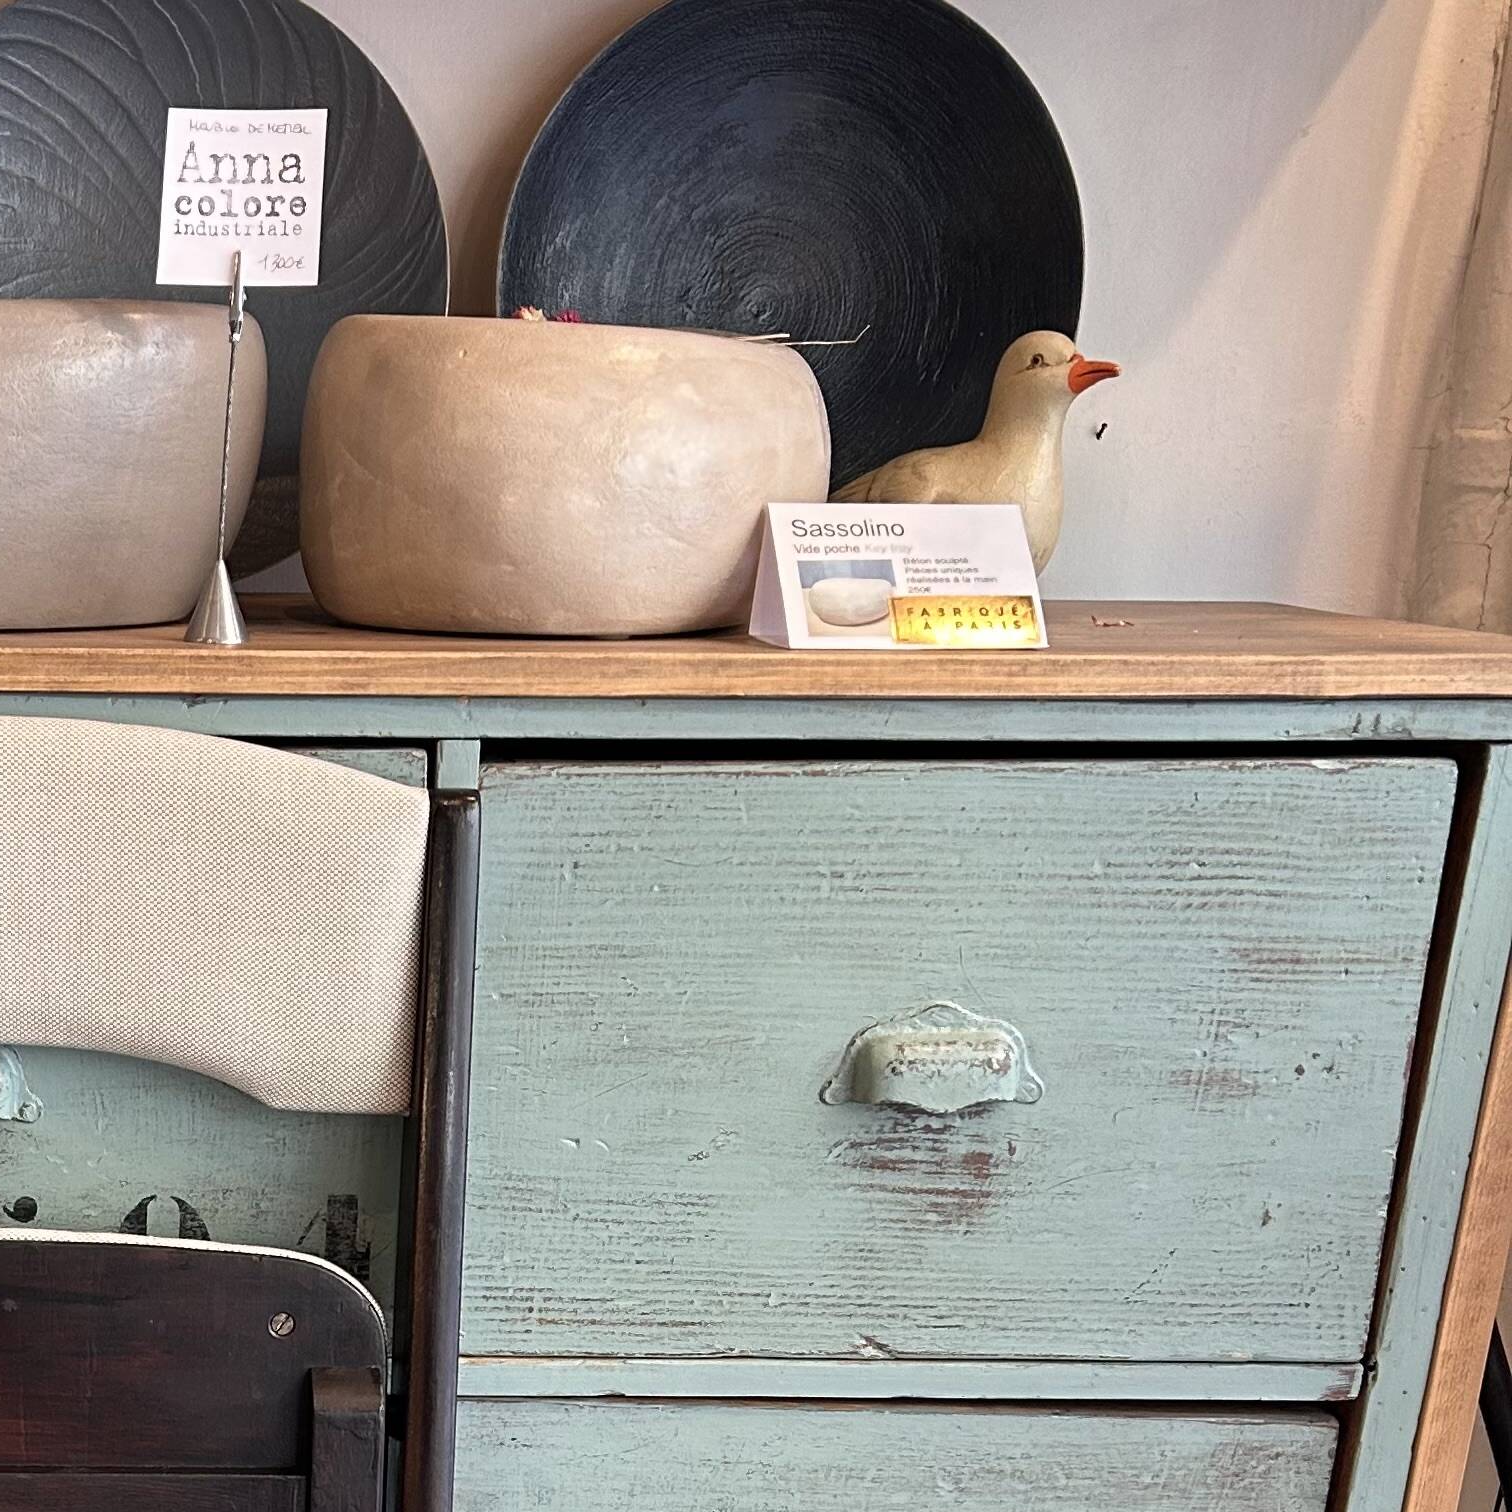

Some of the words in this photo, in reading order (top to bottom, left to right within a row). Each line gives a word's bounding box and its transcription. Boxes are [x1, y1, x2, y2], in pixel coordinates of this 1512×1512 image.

[177, 140, 306, 185] Anna
[174, 189, 307, 217] colore
[174, 219, 303, 236] industriale
[791, 518, 905, 538] Sassolino
[793, 543, 820, 554] Vide
[824, 542, 860, 556] poche
[906, 604, 1019, 617] FABRQUÉ
